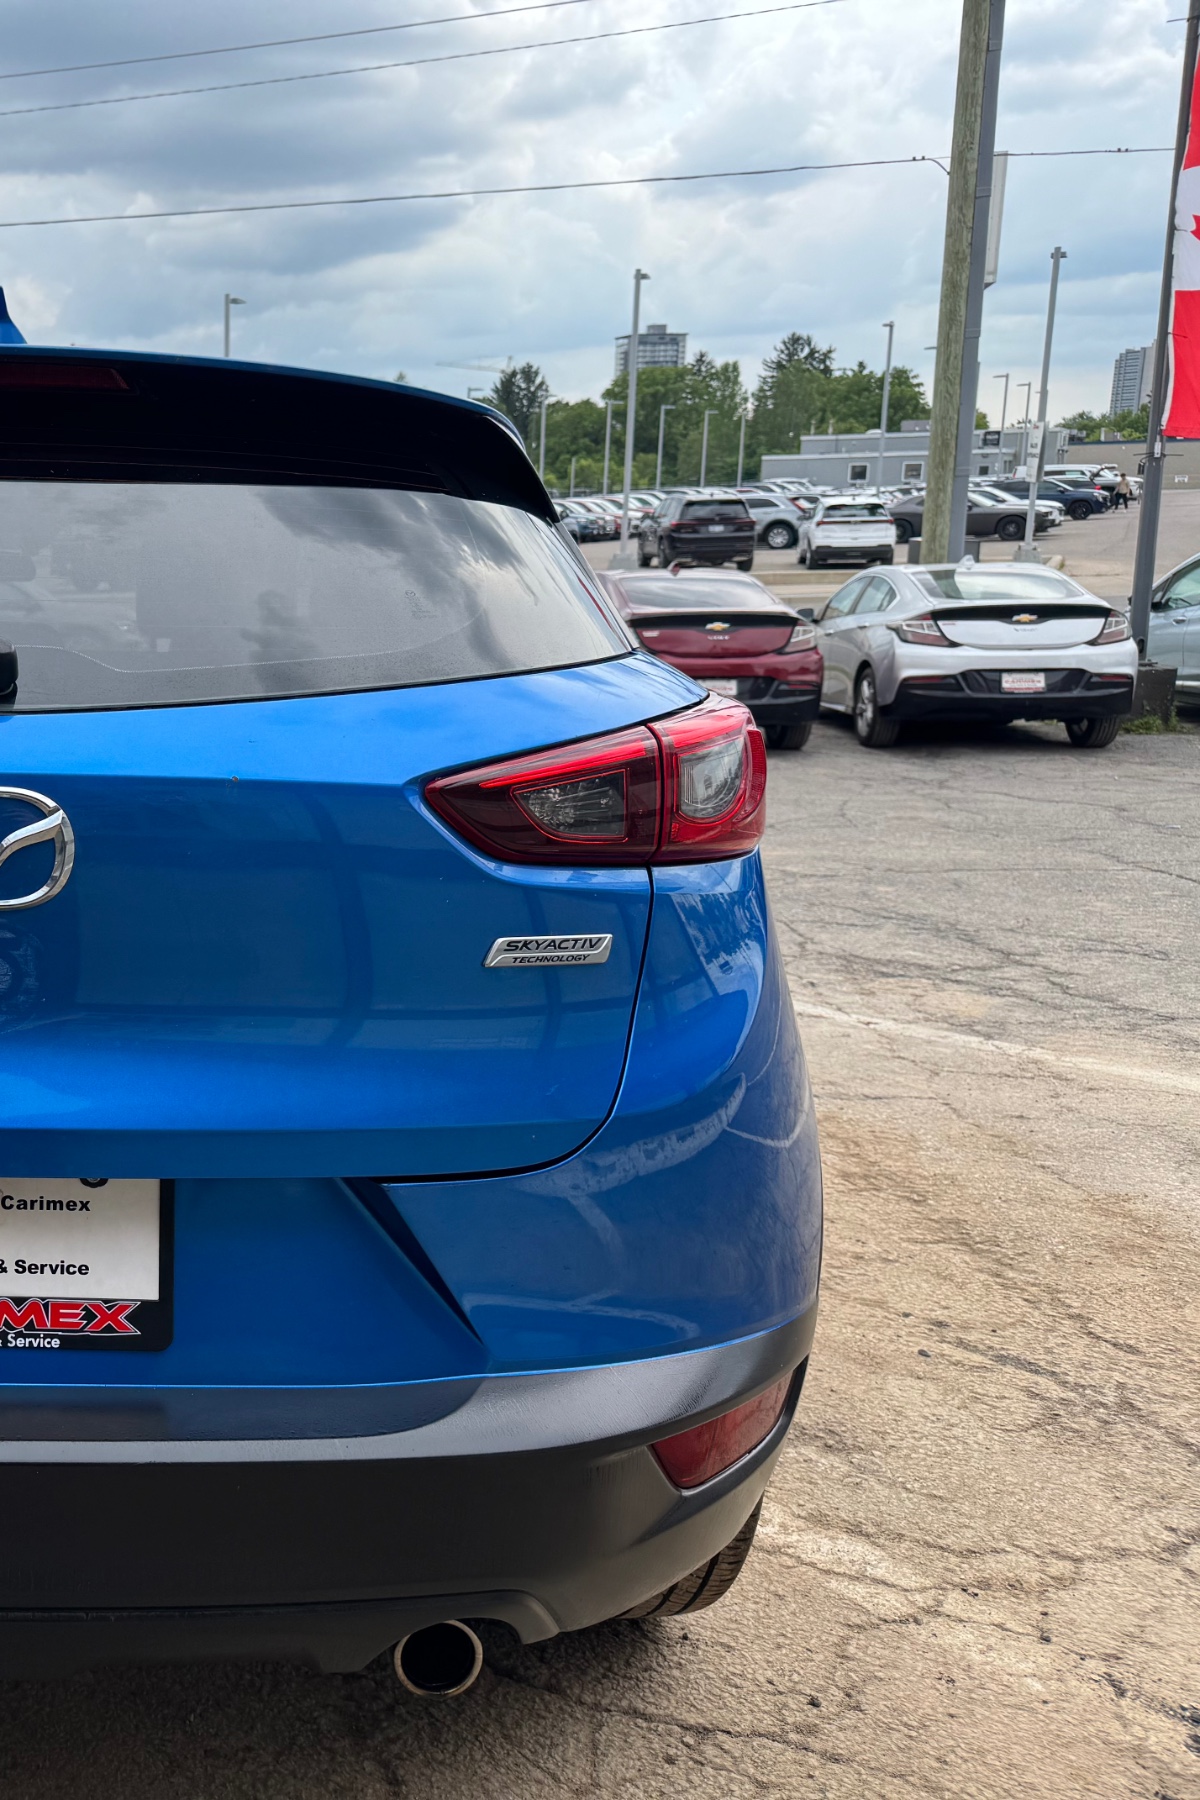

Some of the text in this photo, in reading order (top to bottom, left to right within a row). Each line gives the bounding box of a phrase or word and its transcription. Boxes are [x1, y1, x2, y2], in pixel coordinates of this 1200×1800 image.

[503, 938, 602, 952] SKYACTIV
[511, 953, 591, 964] TECHNOLOGY
[0, 1194, 91, 1212] Carimex
[14, 1259, 90, 1275] Service
[7, 1333, 61, 1348] Service
